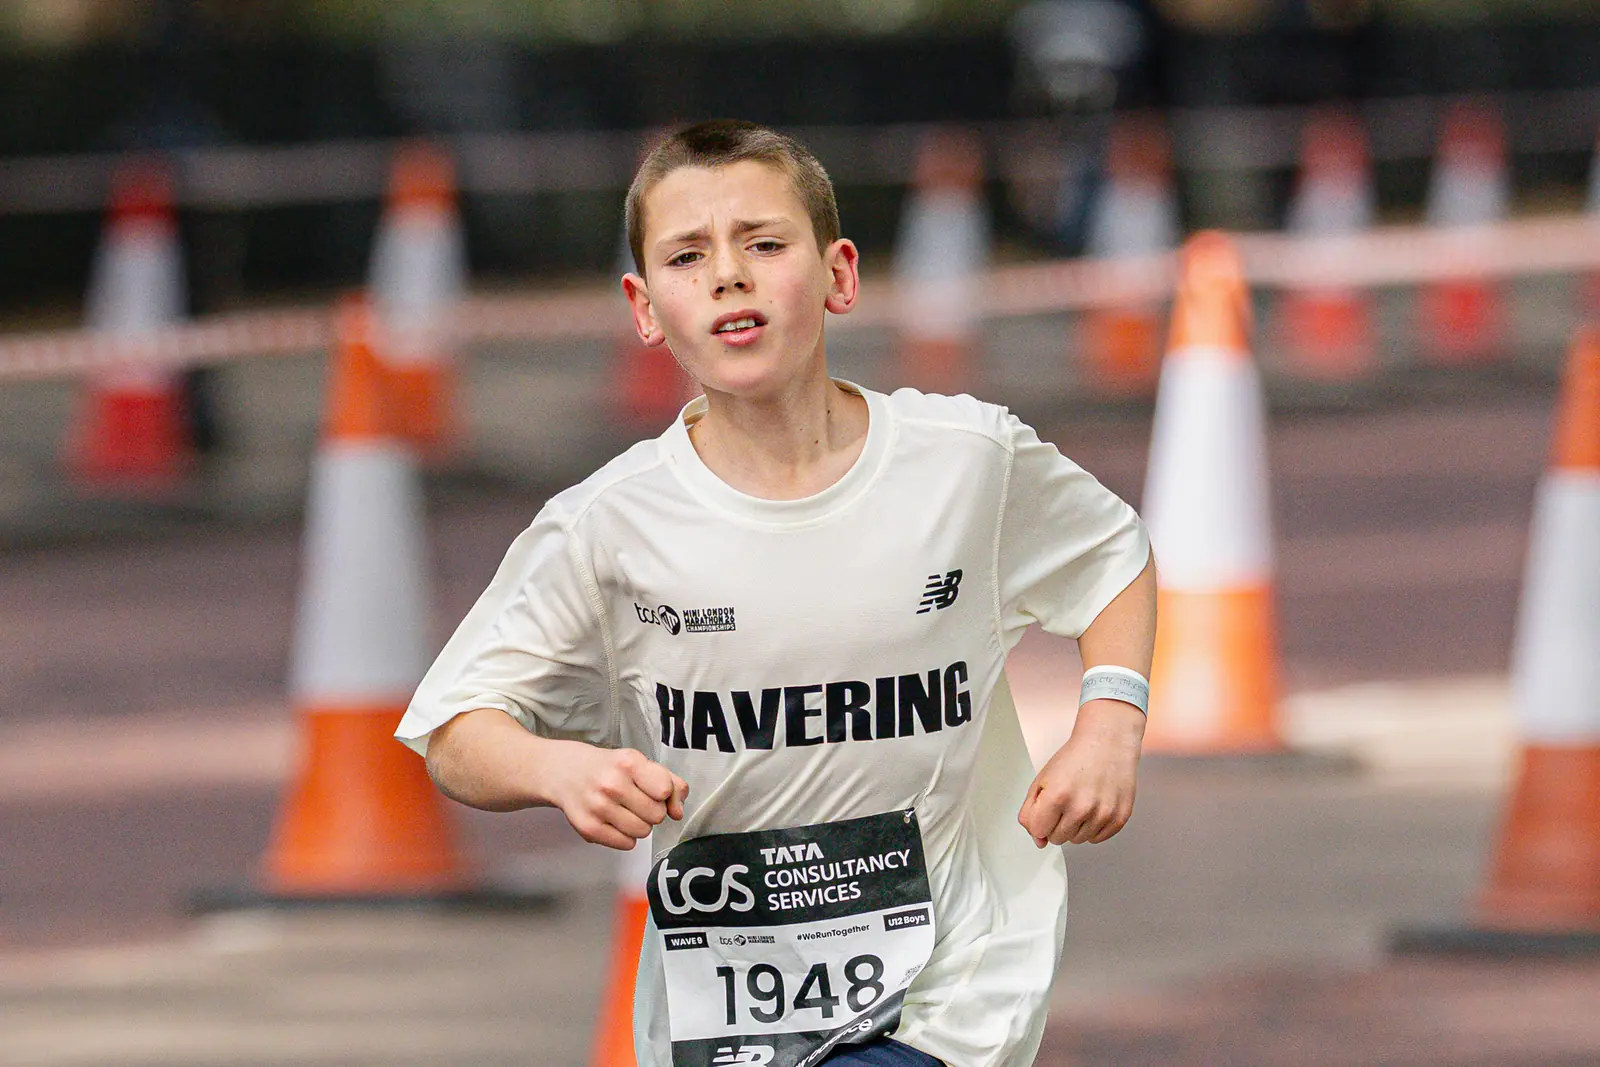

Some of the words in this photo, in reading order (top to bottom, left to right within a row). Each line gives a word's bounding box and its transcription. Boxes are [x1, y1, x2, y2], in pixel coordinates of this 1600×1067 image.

[634, 602, 661, 626] tcs
[683, 609, 700, 617] MINI
[702, 607, 735, 616] LONDON
[685, 615, 724, 625] MARATHON
[725, 615, 735, 624] 26
[686, 624, 735, 632] CHAMPIONSHIPS
[656, 660, 972, 753] HAVERING
[760, 842, 825, 866] TATA
[764, 849, 911, 888] CONSULTANCY
[658, 858, 756, 915] tcs
[767, 881, 862, 911] SERVICES
[888, 917, 903, 927] U12
[904, 914, 926, 926] Boys
[670, 937, 697, 946] WAVE
[719, 935, 733, 945] tcs
[797, 924, 870, 941] #WeRunTogether
[716, 954, 885, 1025] 1948
